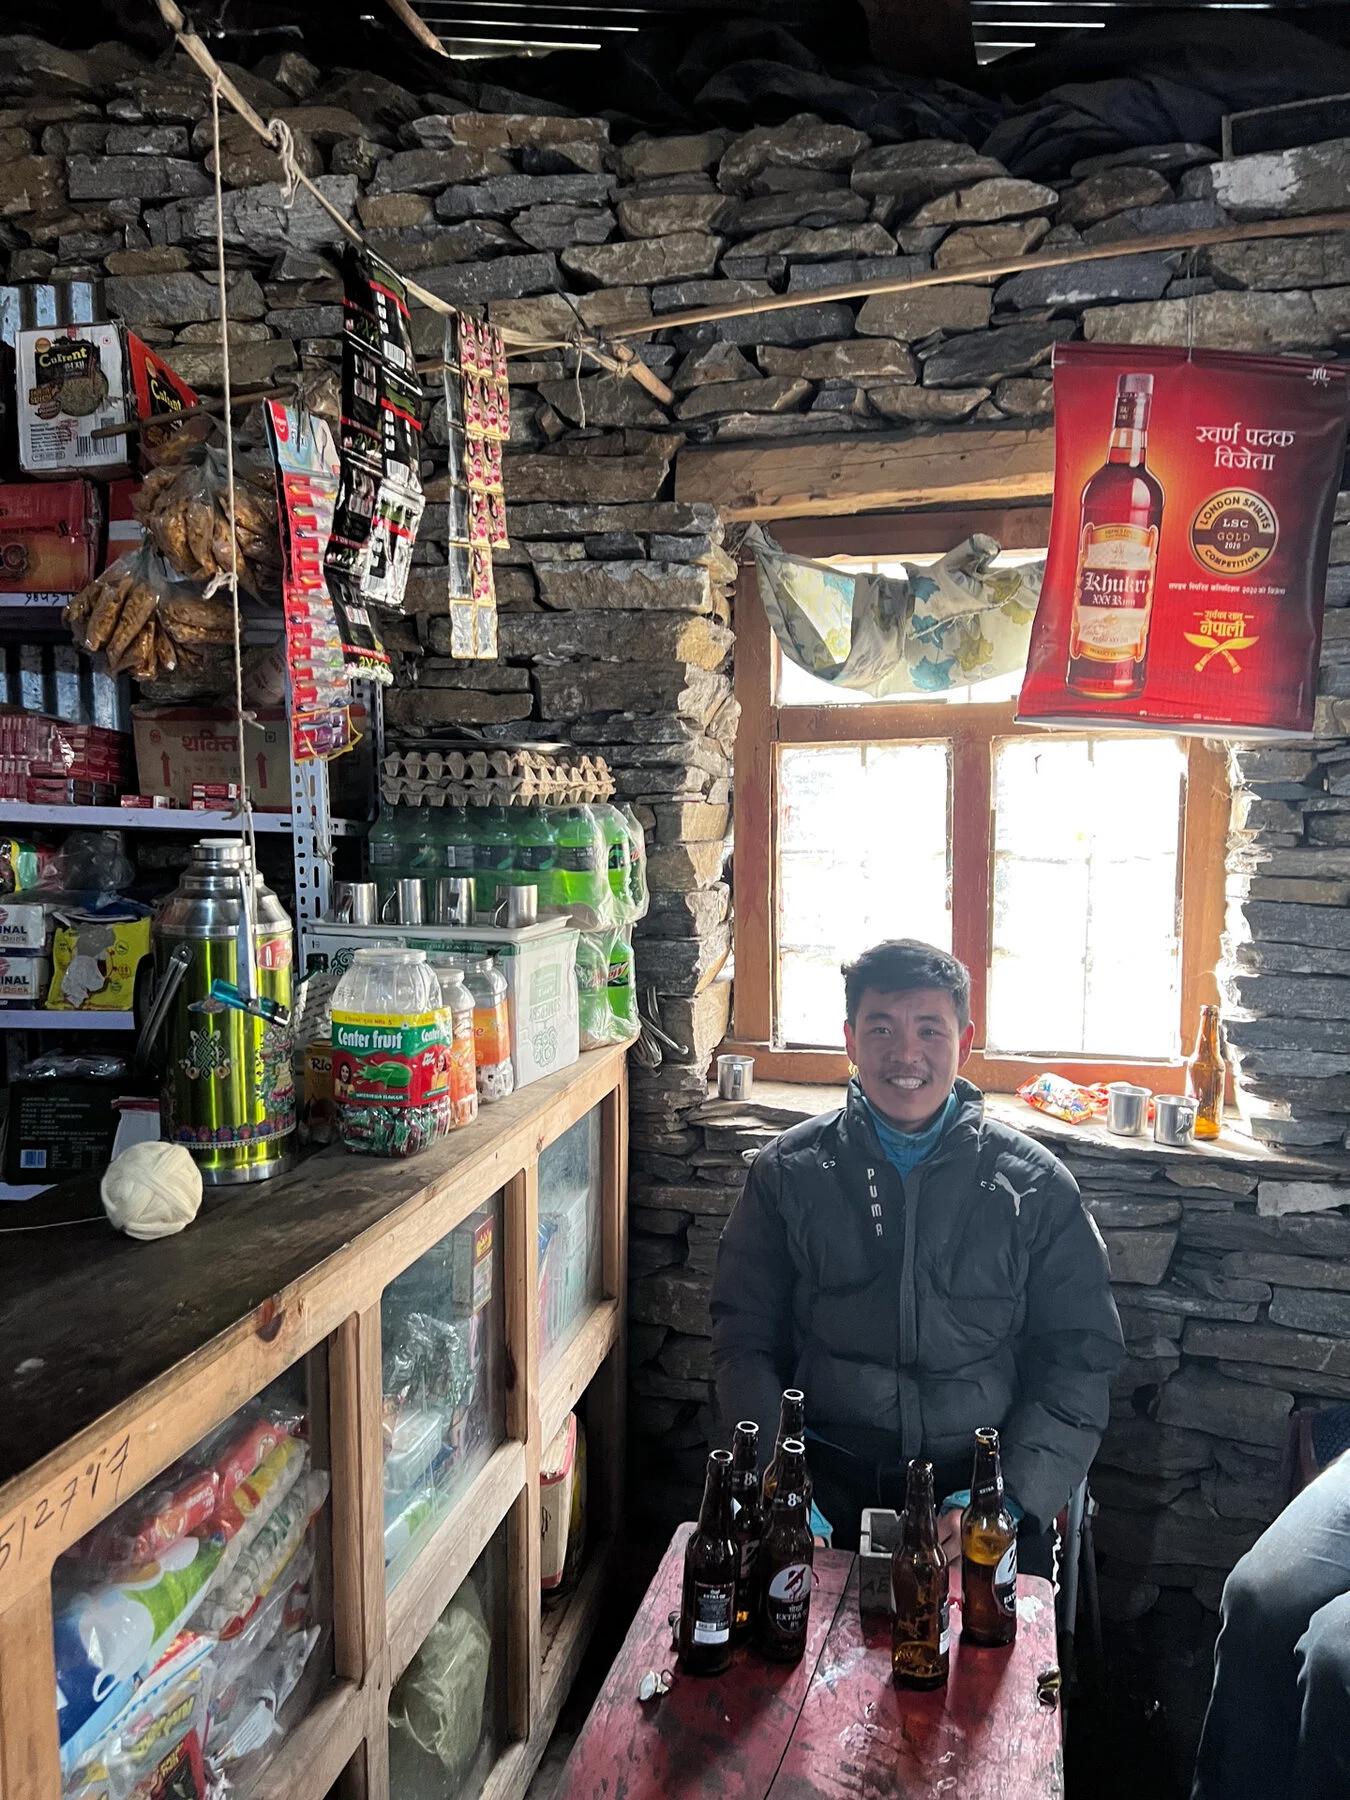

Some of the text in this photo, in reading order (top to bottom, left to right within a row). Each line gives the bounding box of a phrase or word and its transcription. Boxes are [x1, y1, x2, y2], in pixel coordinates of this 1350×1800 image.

[39, 347, 88, 368] Current
[1196, 422, 1296, 448] स्वर्ण पदक
[1214, 445, 1275, 471] विजेता
[1200, 496, 1271, 529] LONDON SPIRITS
[1223, 518, 1249, 528] LSC
[1217, 531, 1250, 542] GOLD
[1225, 541, 1241, 550] 2020
[1205, 549, 1260, 568] COMPETITION
[1084, 572, 1147, 594] Khukri
[1200, 618, 1246, 638] नेपाली
[182, 729, 238, 752] शक्ति
[338, 1027, 403, 1049] Center fruit
[867, 1168, 884, 1237] PUMA
